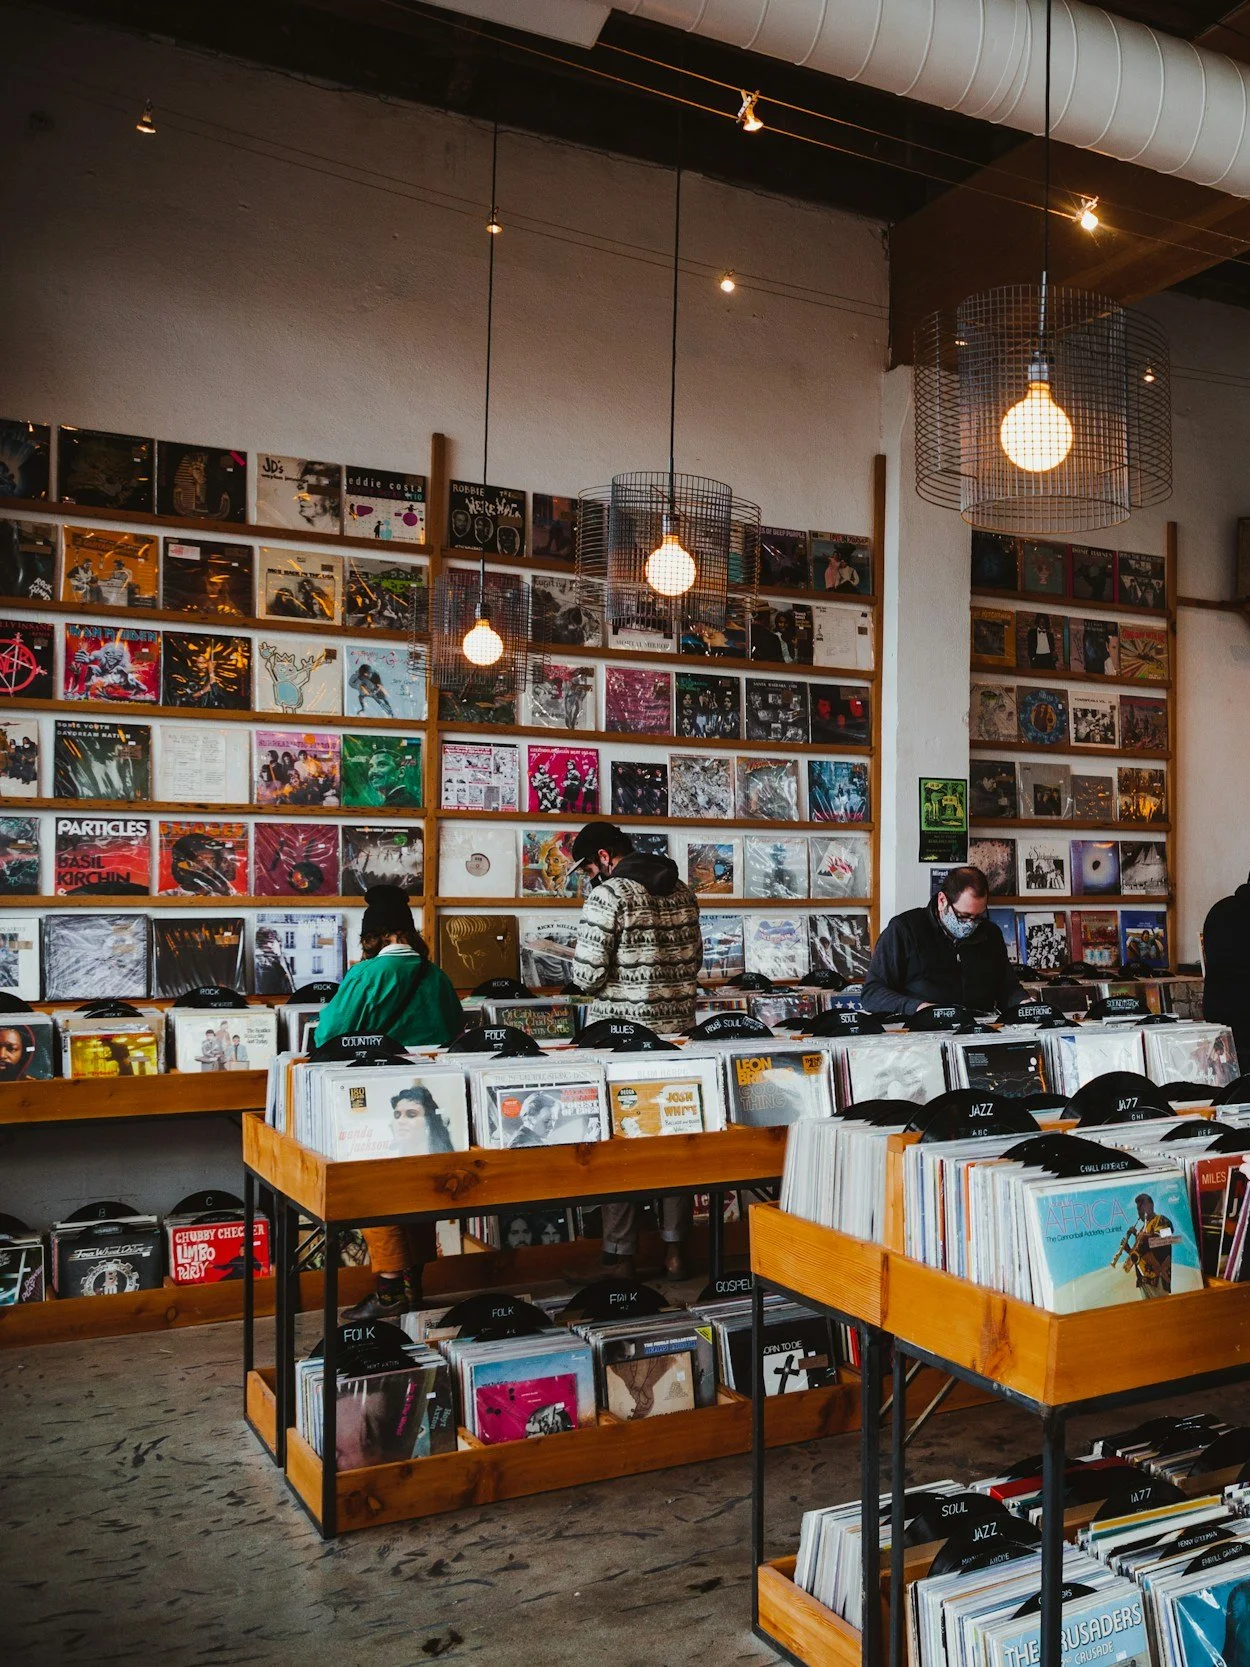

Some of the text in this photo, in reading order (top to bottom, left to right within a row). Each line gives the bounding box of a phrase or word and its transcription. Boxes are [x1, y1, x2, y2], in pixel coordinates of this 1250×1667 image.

[348, 476, 382, 490] eddie
[389, 482, 423, 494] costa
[452, 483, 485, 498] ROBBIE
[57, 820, 147, 836] PARTICLES
[57, 854, 105, 869] BASIL
[57, 872, 130, 886] KIRCHIN
[313, 983, 332, 991] ROCK
[840, 1015, 858, 1024] SOUL
[1018, 1007, 1052, 1017] ELECTRONIC
[610, 1025, 634, 1034] BLUES
[723, 1018, 742, 1027] SOUL
[342, 1037, 383, 1048] COUNTRY
[484, 1030, 506, 1040] FOLK
[736, 1057, 773, 1072] LEON
[666, 1091, 693, 1103] JOSH
[739, 1094, 787, 1112] THING
[969, 1103, 993, 1118] JAZZ
[1201, 1171, 1227, 1185] MILES
[1043, 1198, 1129, 1236] AFRICA
[175, 1223, 265, 1244] CHUBBY CHECER
[1057, 1231, 1084, 1242] Cannonball
[716, 1279, 753, 1293] GOSPEL
[609, 1291, 638, 1305] FOLK
[492, 1306, 514, 1318] FOLK
[343, 1327, 376, 1343] FOLK
[763, 1344, 781, 1355] ORN
[791, 1339, 803, 1349] DIE
[941, 1502, 968, 1517] SOUL
[972, 1521, 997, 1542] JAZZ
[1004, 1602, 1142, 1667] THE RUSADERS
[1073, 1642, 1114, 1664] CRUSADE
